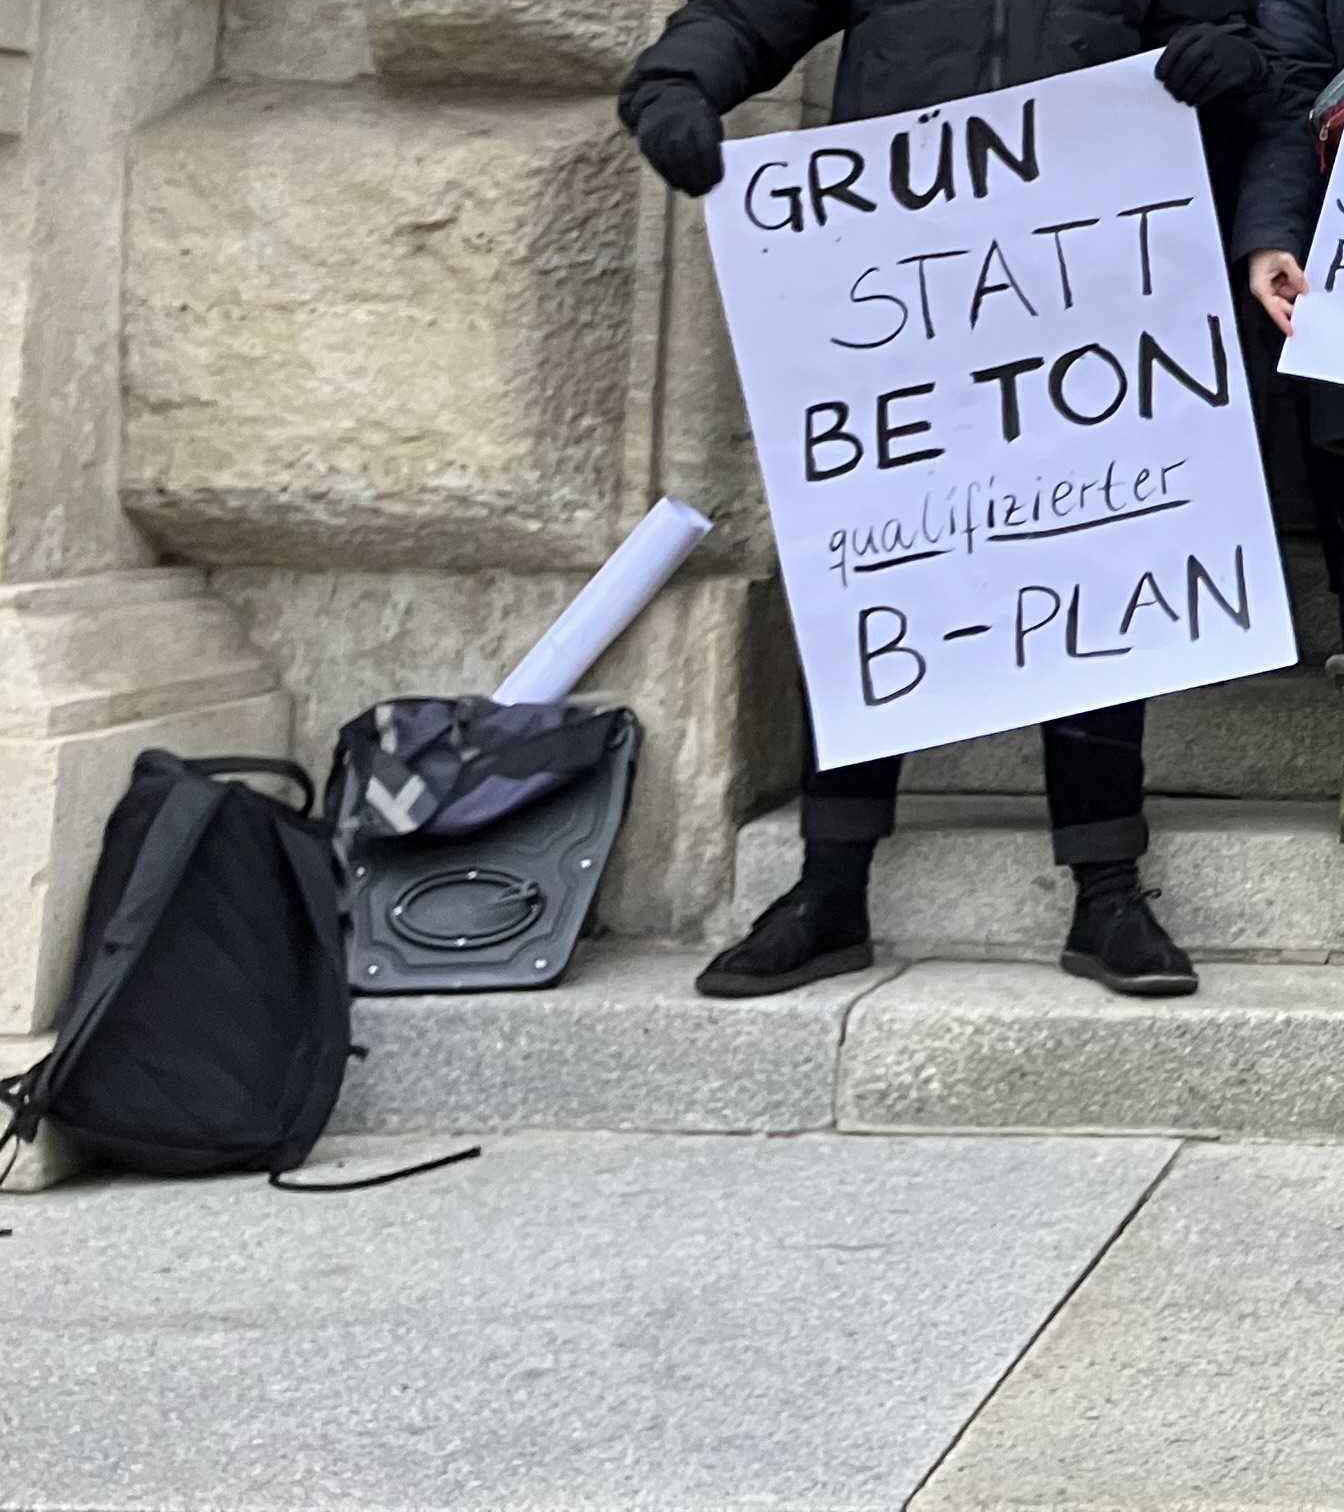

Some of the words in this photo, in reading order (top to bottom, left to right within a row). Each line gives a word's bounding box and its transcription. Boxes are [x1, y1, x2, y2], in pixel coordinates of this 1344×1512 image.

[744, 97, 1040, 233] GRÜN
[831, 197, 1195, 350] STATT
[804, 313, 1230, 483] BETON
[828, 457, 1189, 589] qualifizierter
[858, 544, 1252, 708] B-PLAN
